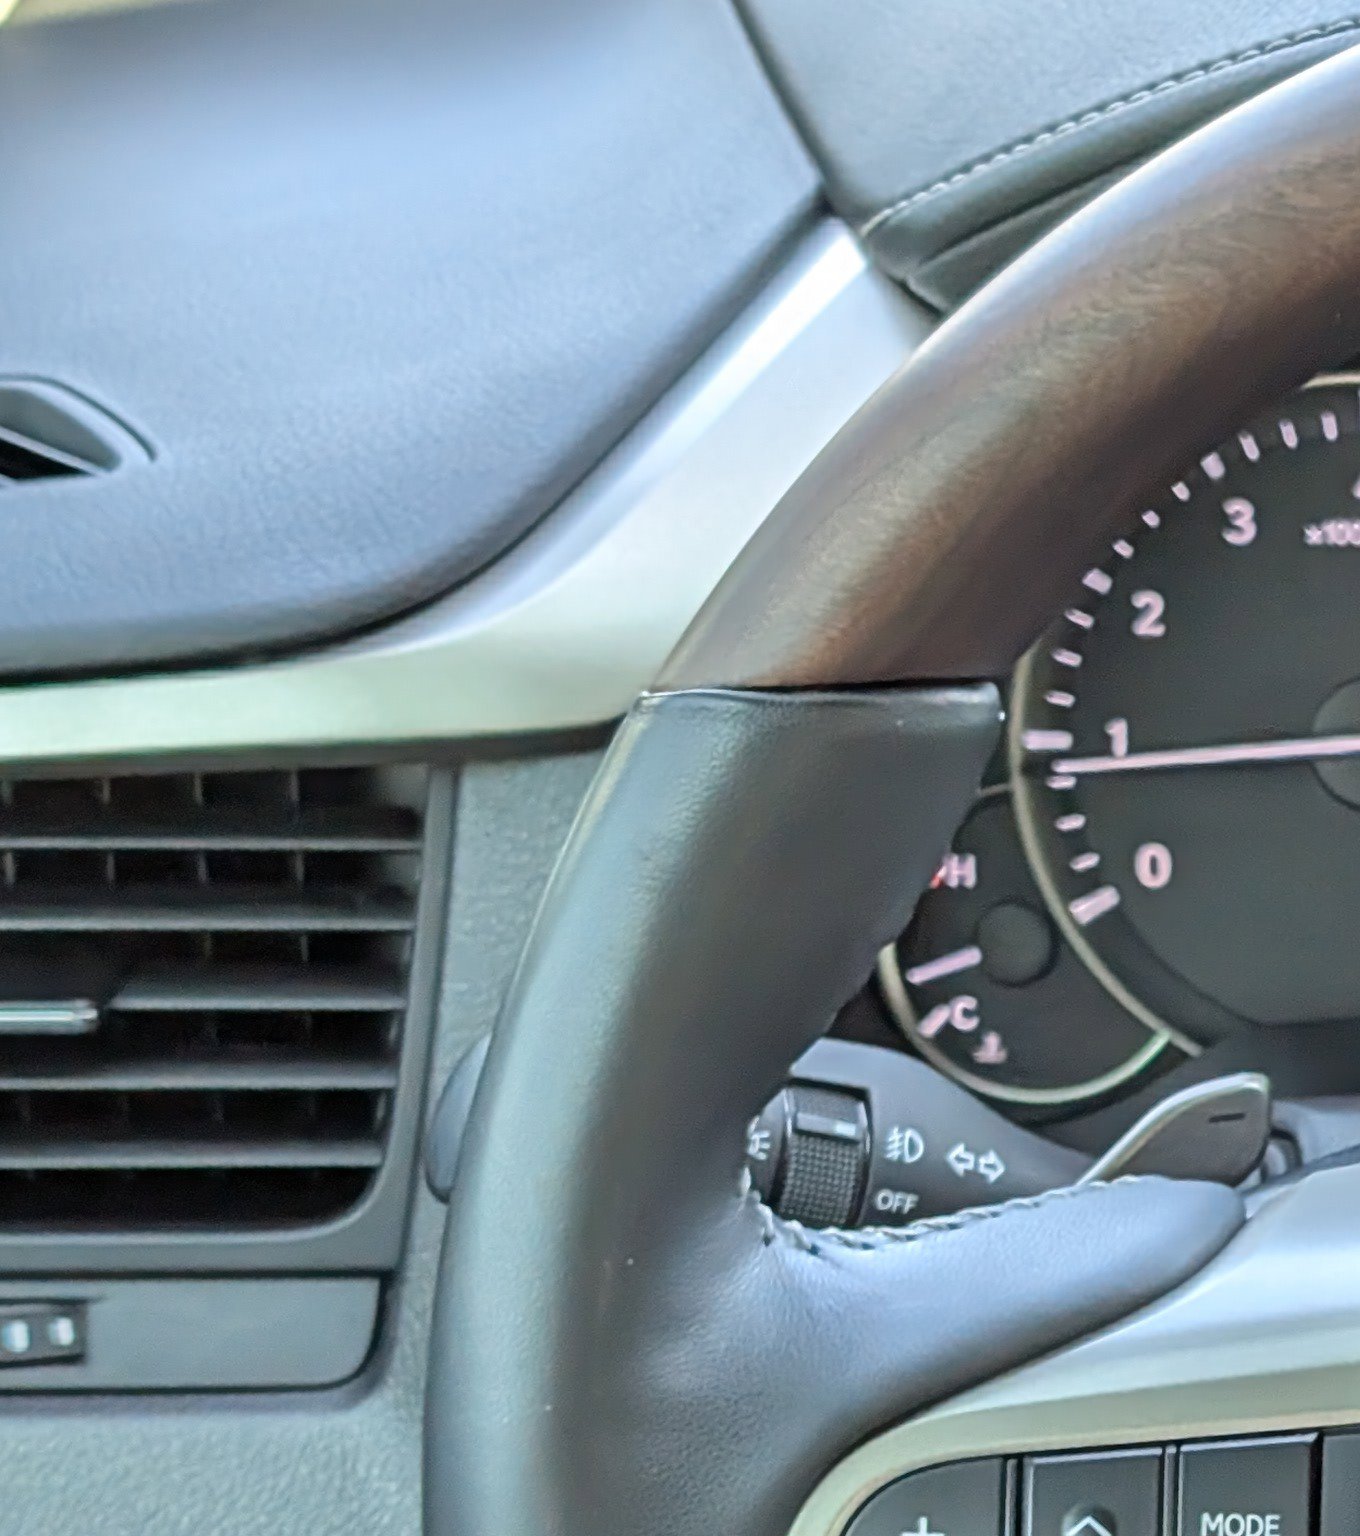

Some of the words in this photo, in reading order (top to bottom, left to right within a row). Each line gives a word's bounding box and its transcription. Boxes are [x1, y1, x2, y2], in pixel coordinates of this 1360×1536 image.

[1223, 499, 1256, 545] 3
[1132, 591, 1165, 637] 2
[1106, 719, 1129, 756] 1
[946, 853, 976, 888] H
[1135, 844, 1172, 888] 0
[951, 995, 979, 1031] C
[875, 1189, 918, 1213] OFF
